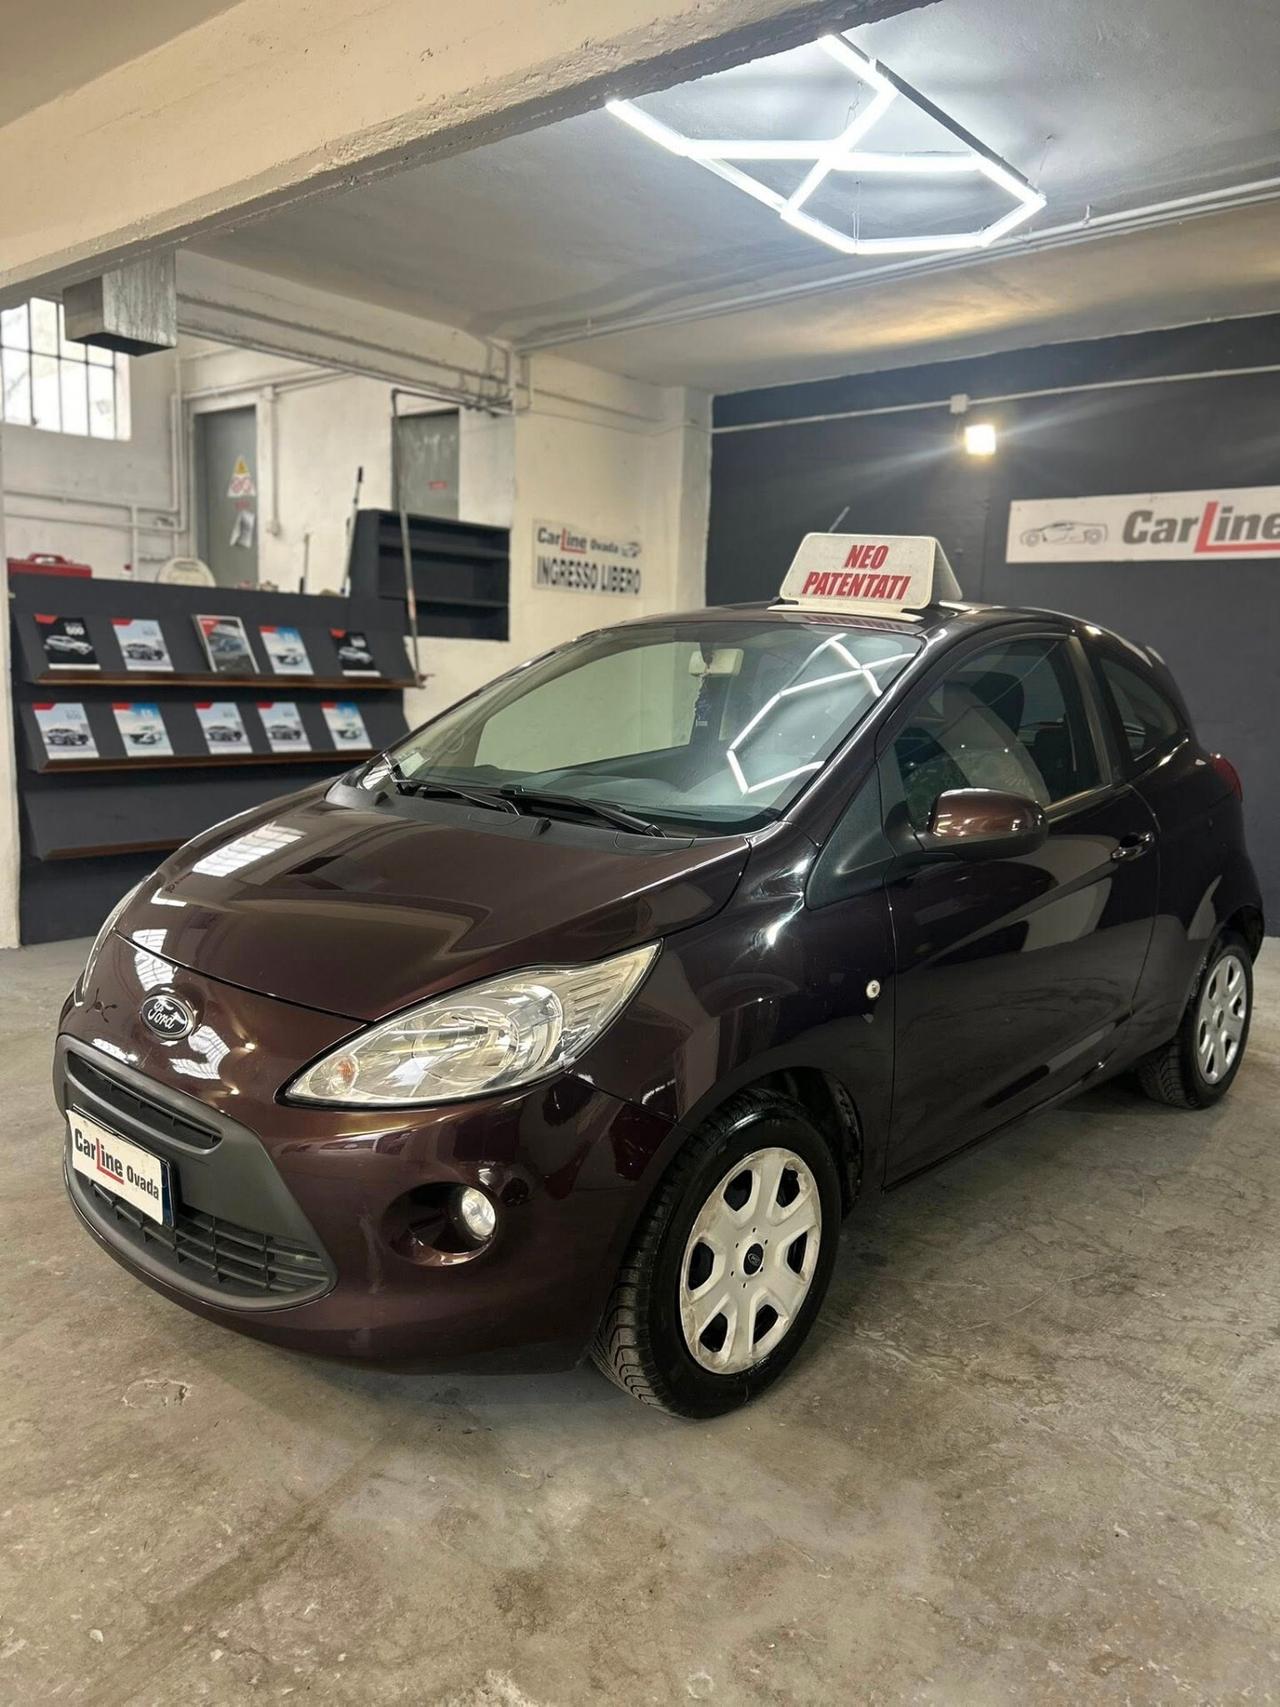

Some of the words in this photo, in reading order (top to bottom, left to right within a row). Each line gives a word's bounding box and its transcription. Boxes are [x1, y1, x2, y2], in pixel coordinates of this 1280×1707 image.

[538, 527, 587, 554] CarLine
[590, 539, 619, 554] Ovada
[844, 544, 889, 570] NEO
[537, 556, 598, 588] INGRESSO
[602, 564, 641, 595] LIBERO
[801, 571, 911, 600] PATENTATI
[147, 999, 186, 1029] Ford
[75, 1128, 124, 1185] CarLine
[126, 1165, 159, 1200] Ovada
